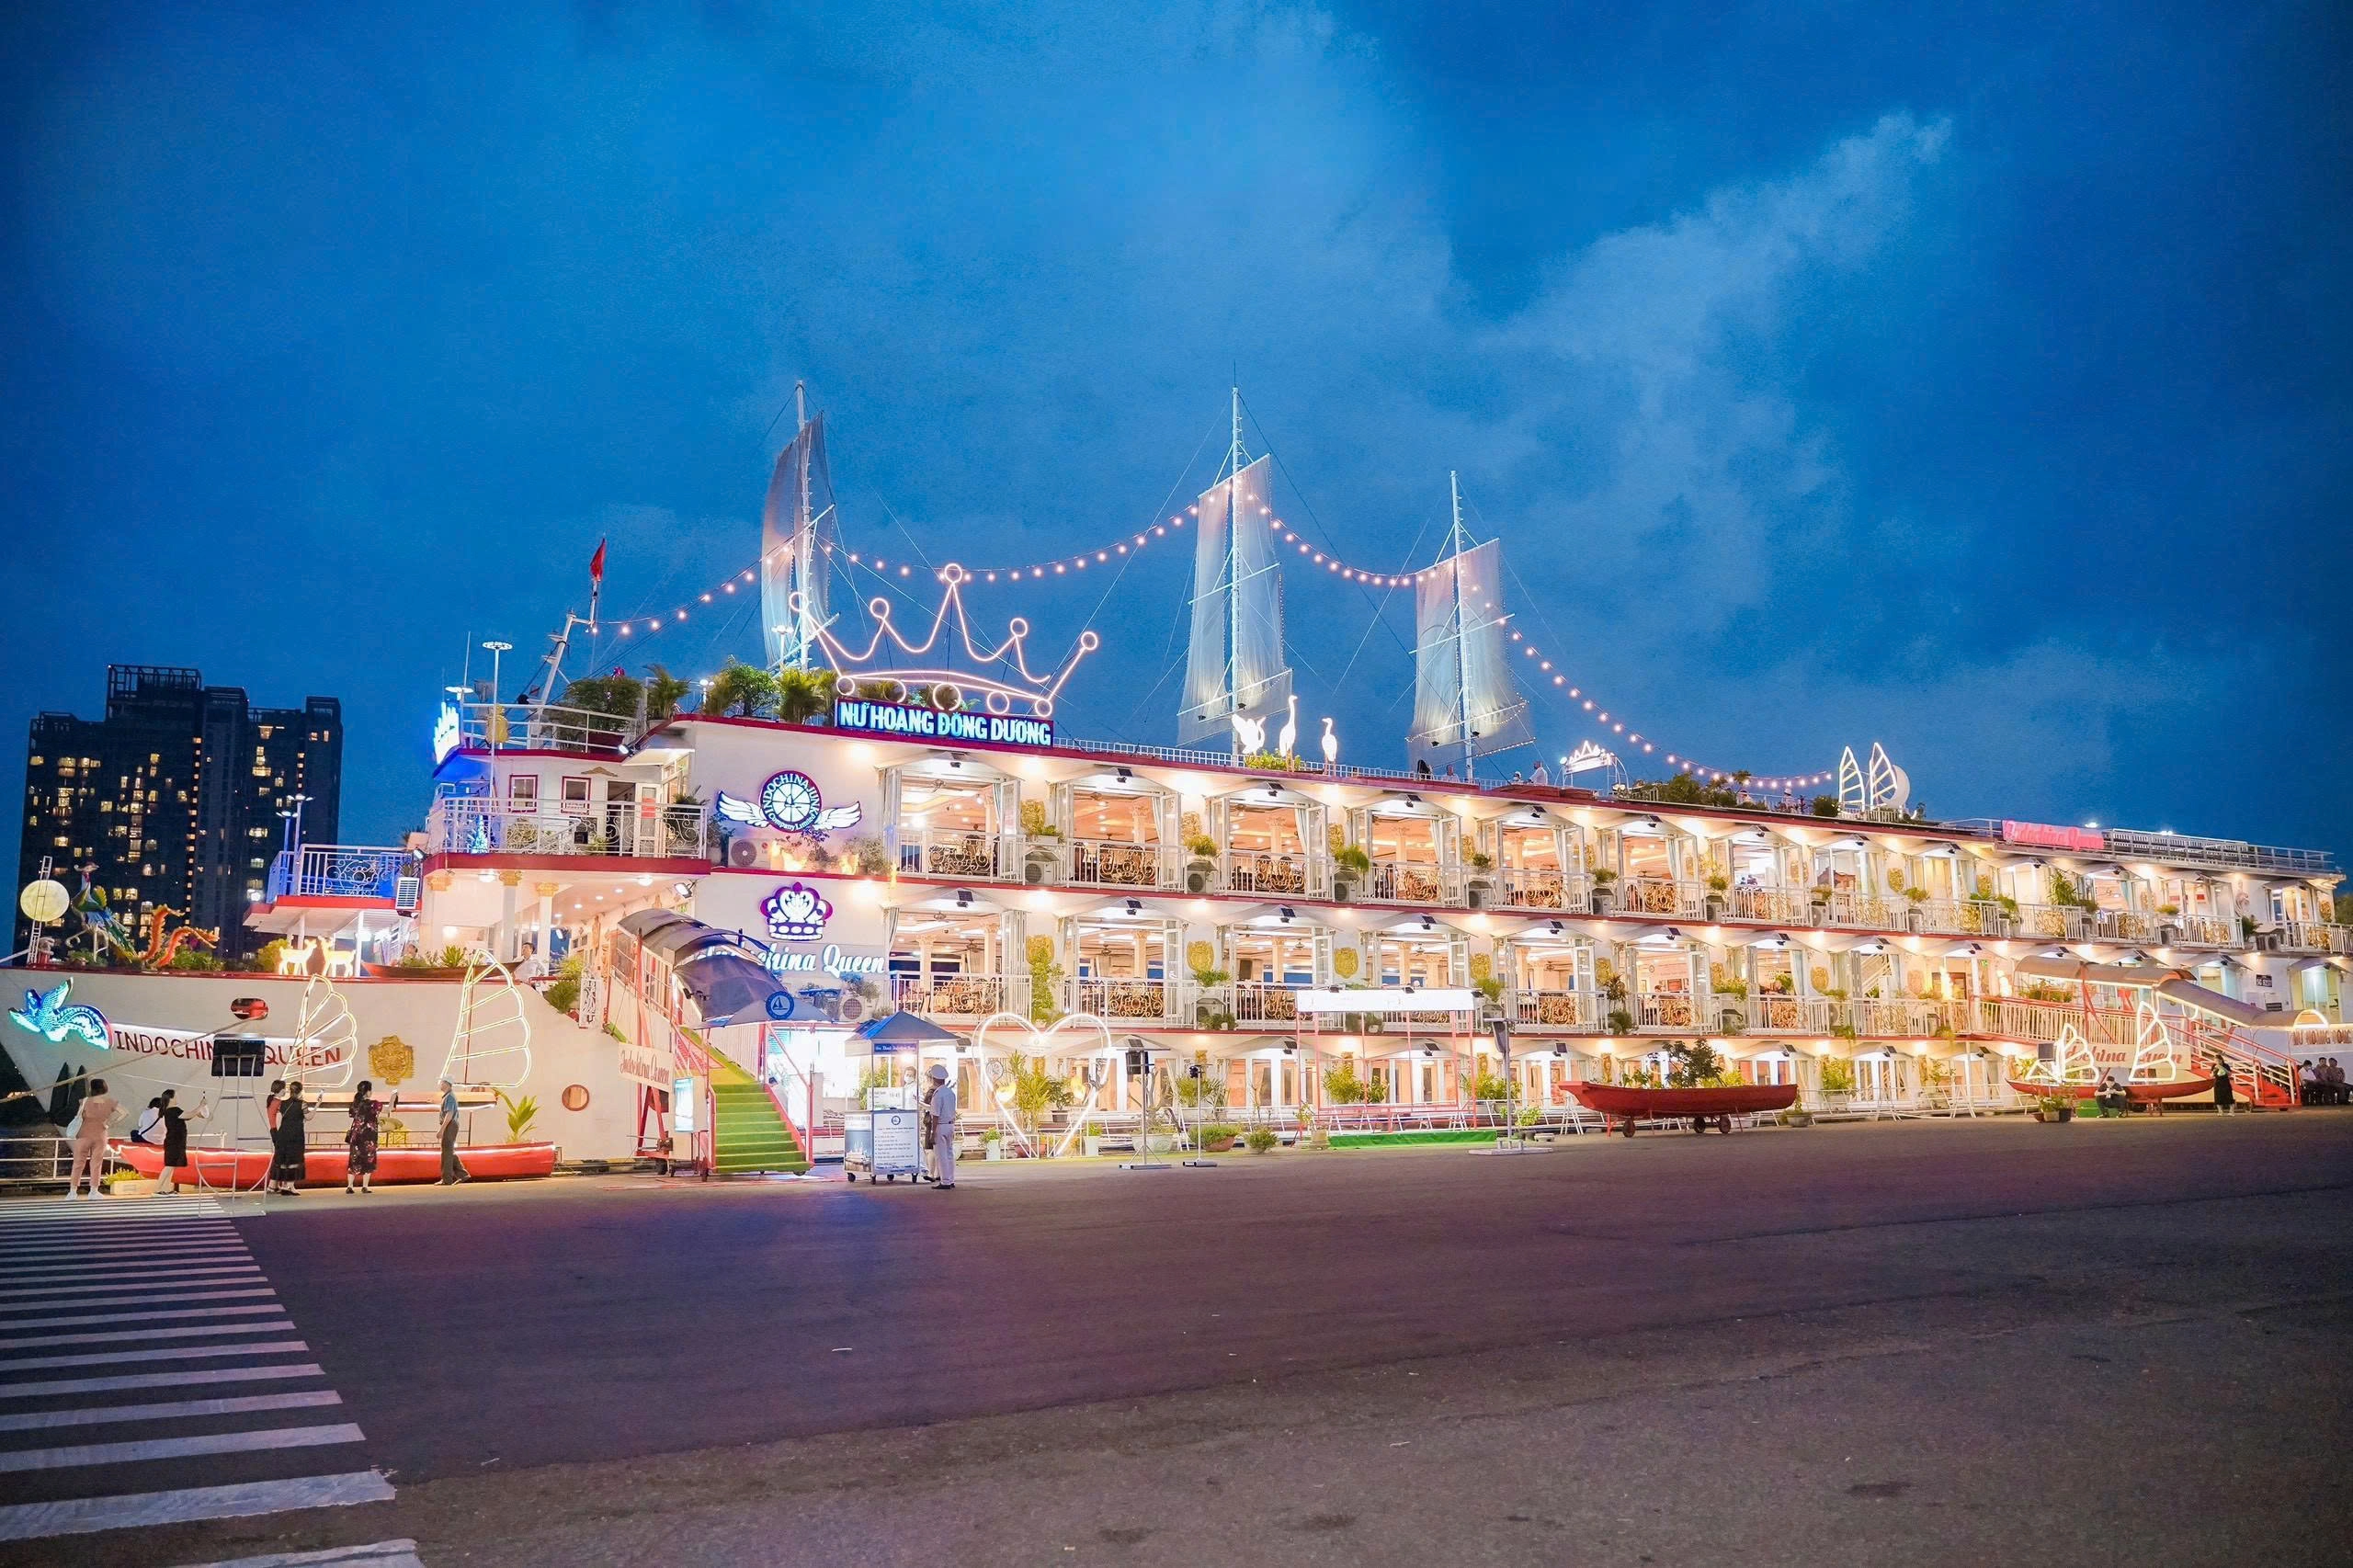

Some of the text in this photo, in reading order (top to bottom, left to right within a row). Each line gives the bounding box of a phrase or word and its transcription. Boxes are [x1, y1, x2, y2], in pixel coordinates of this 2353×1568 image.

[763, 773, 820, 817] INDOCHINA JUNK
[823, 944, 885, 979] Queen
